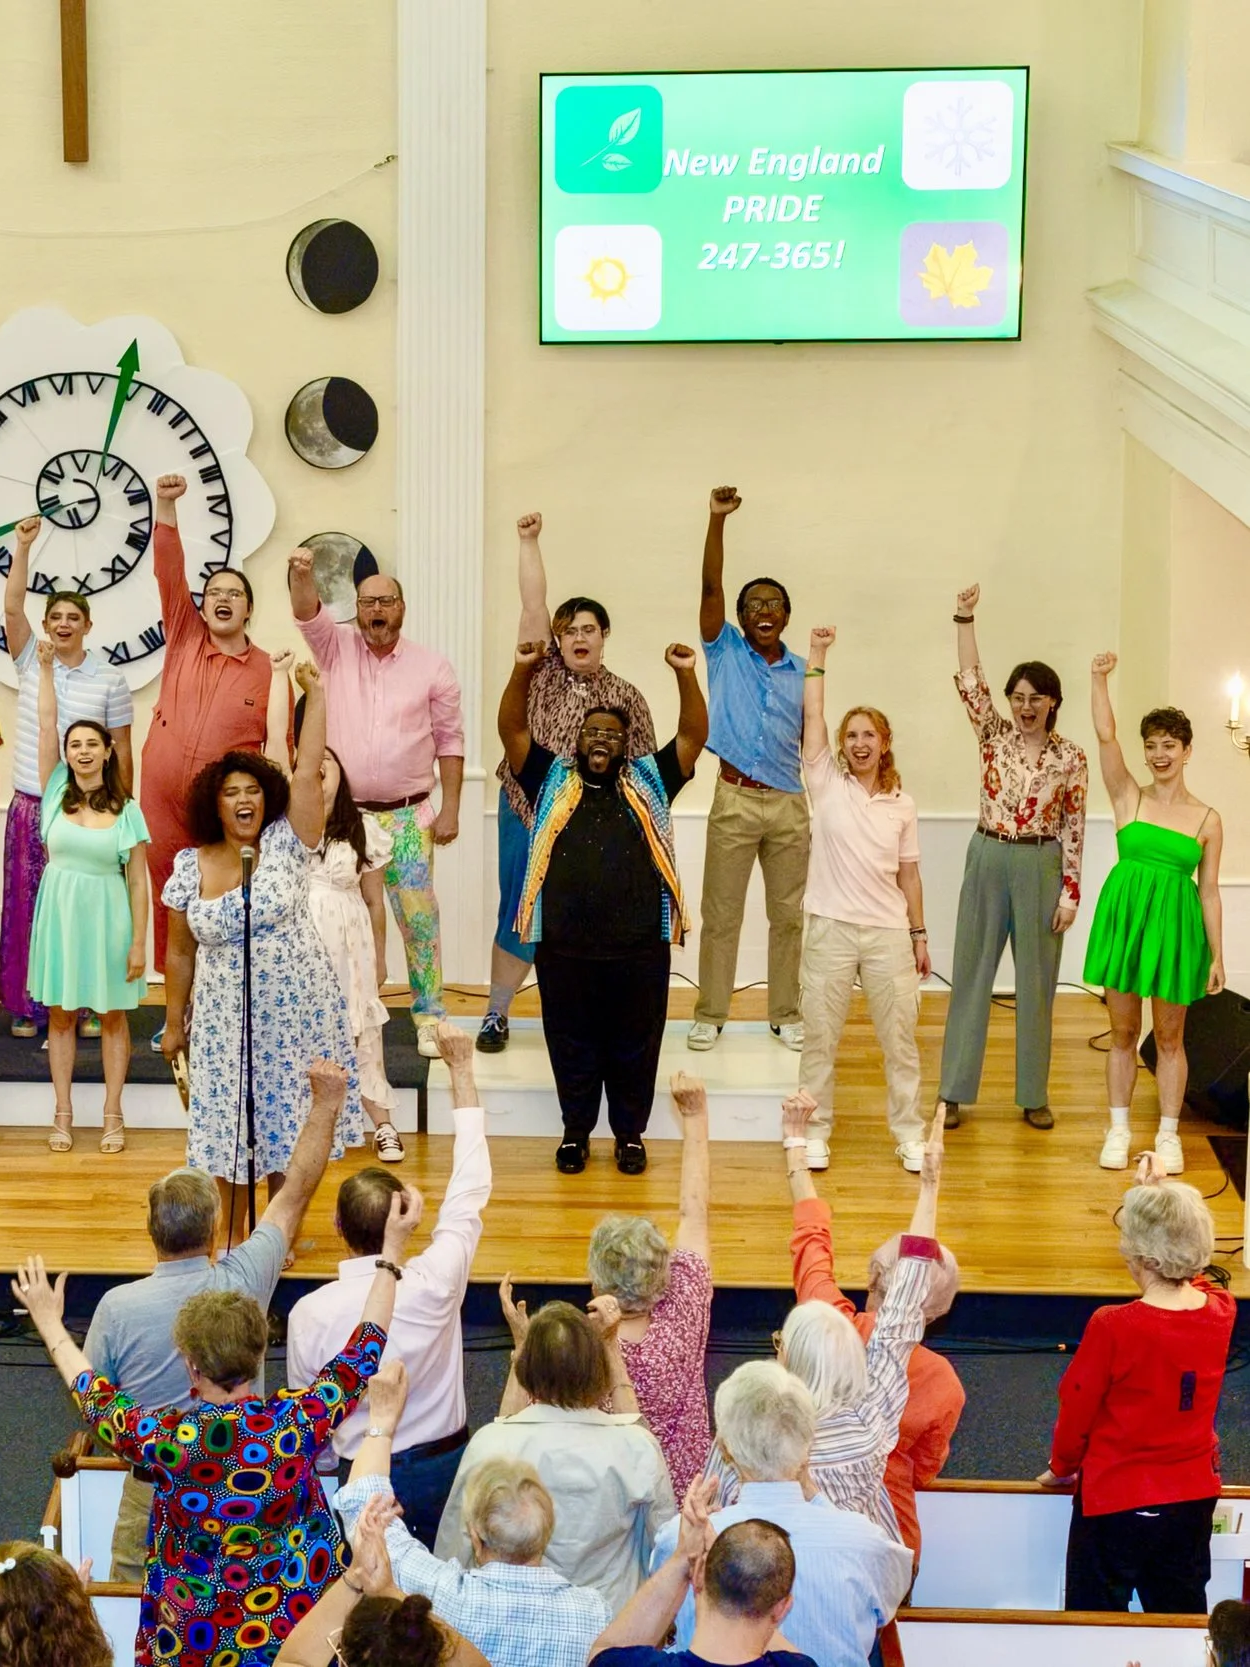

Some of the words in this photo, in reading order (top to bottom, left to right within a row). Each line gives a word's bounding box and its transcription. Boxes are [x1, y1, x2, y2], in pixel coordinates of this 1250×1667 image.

[663, 149, 740, 177] New
[749, 145, 886, 182] England
[722, 195, 824, 224] PRIDE
[698, 241, 846, 271] 247-365!
